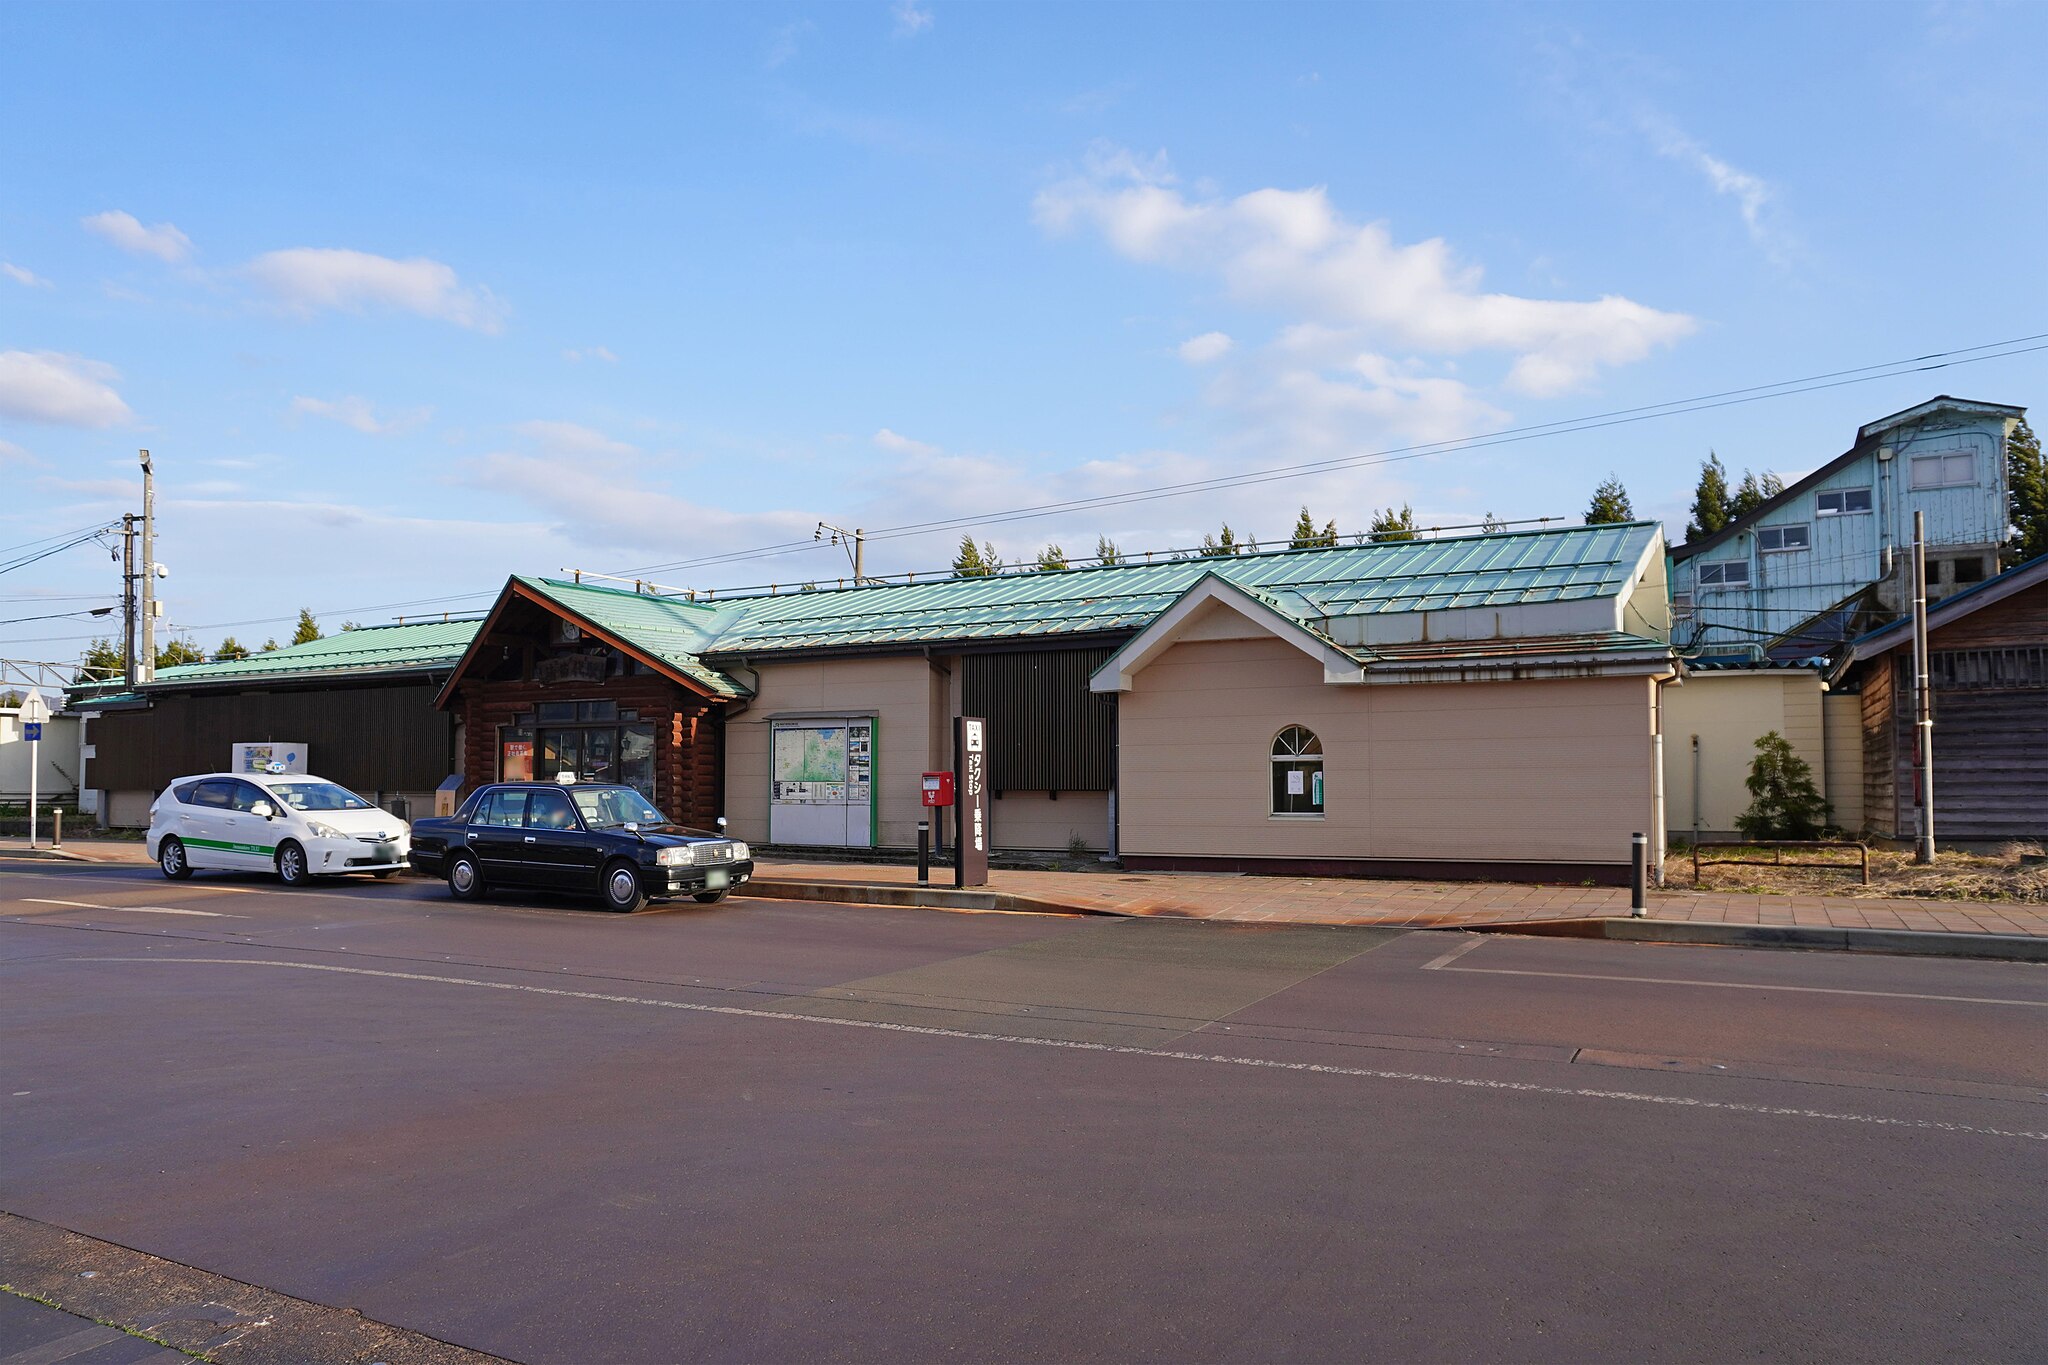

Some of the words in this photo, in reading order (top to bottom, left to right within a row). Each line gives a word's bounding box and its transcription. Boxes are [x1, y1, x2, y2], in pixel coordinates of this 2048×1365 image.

[969, 723, 981, 731] TAXI
[973, 754, 983, 851] タクシー乗降場
